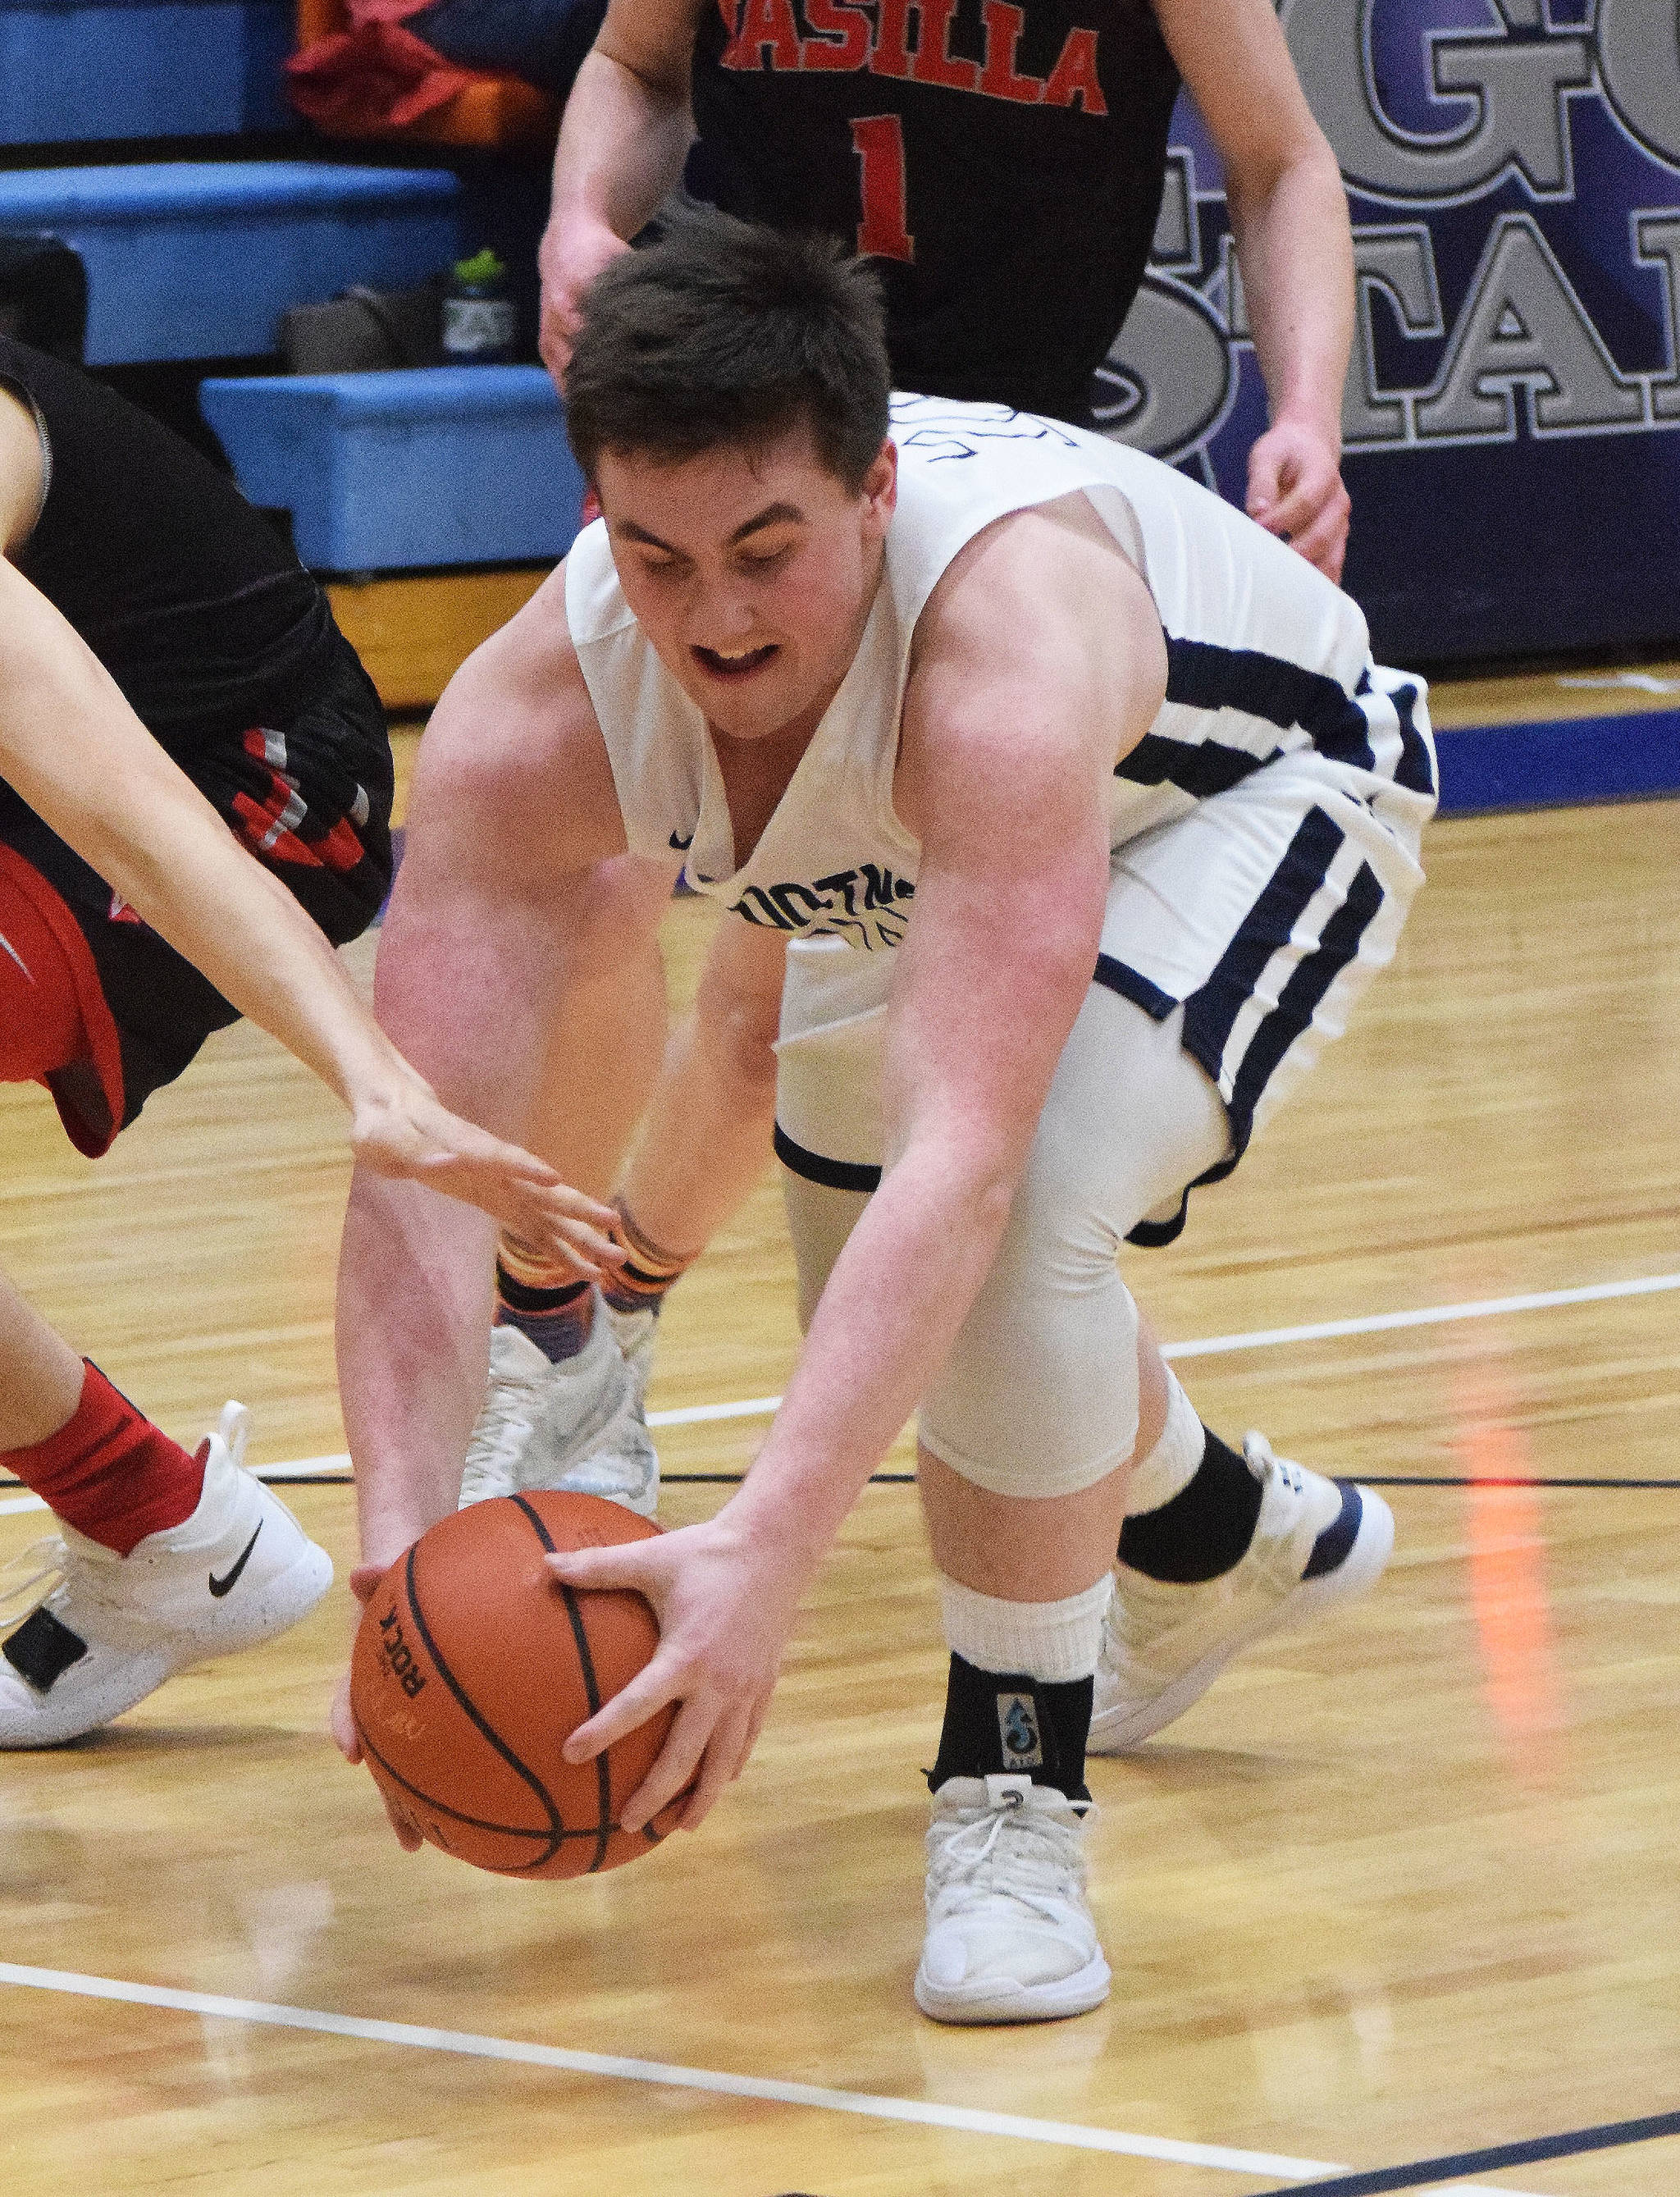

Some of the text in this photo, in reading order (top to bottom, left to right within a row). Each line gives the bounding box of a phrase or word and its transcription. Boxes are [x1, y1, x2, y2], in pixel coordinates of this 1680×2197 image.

[718, 0, 1107, 116] ASILLA
[849, 114, 915, 263] 1
[379, 1605, 427, 1698] ROCK
